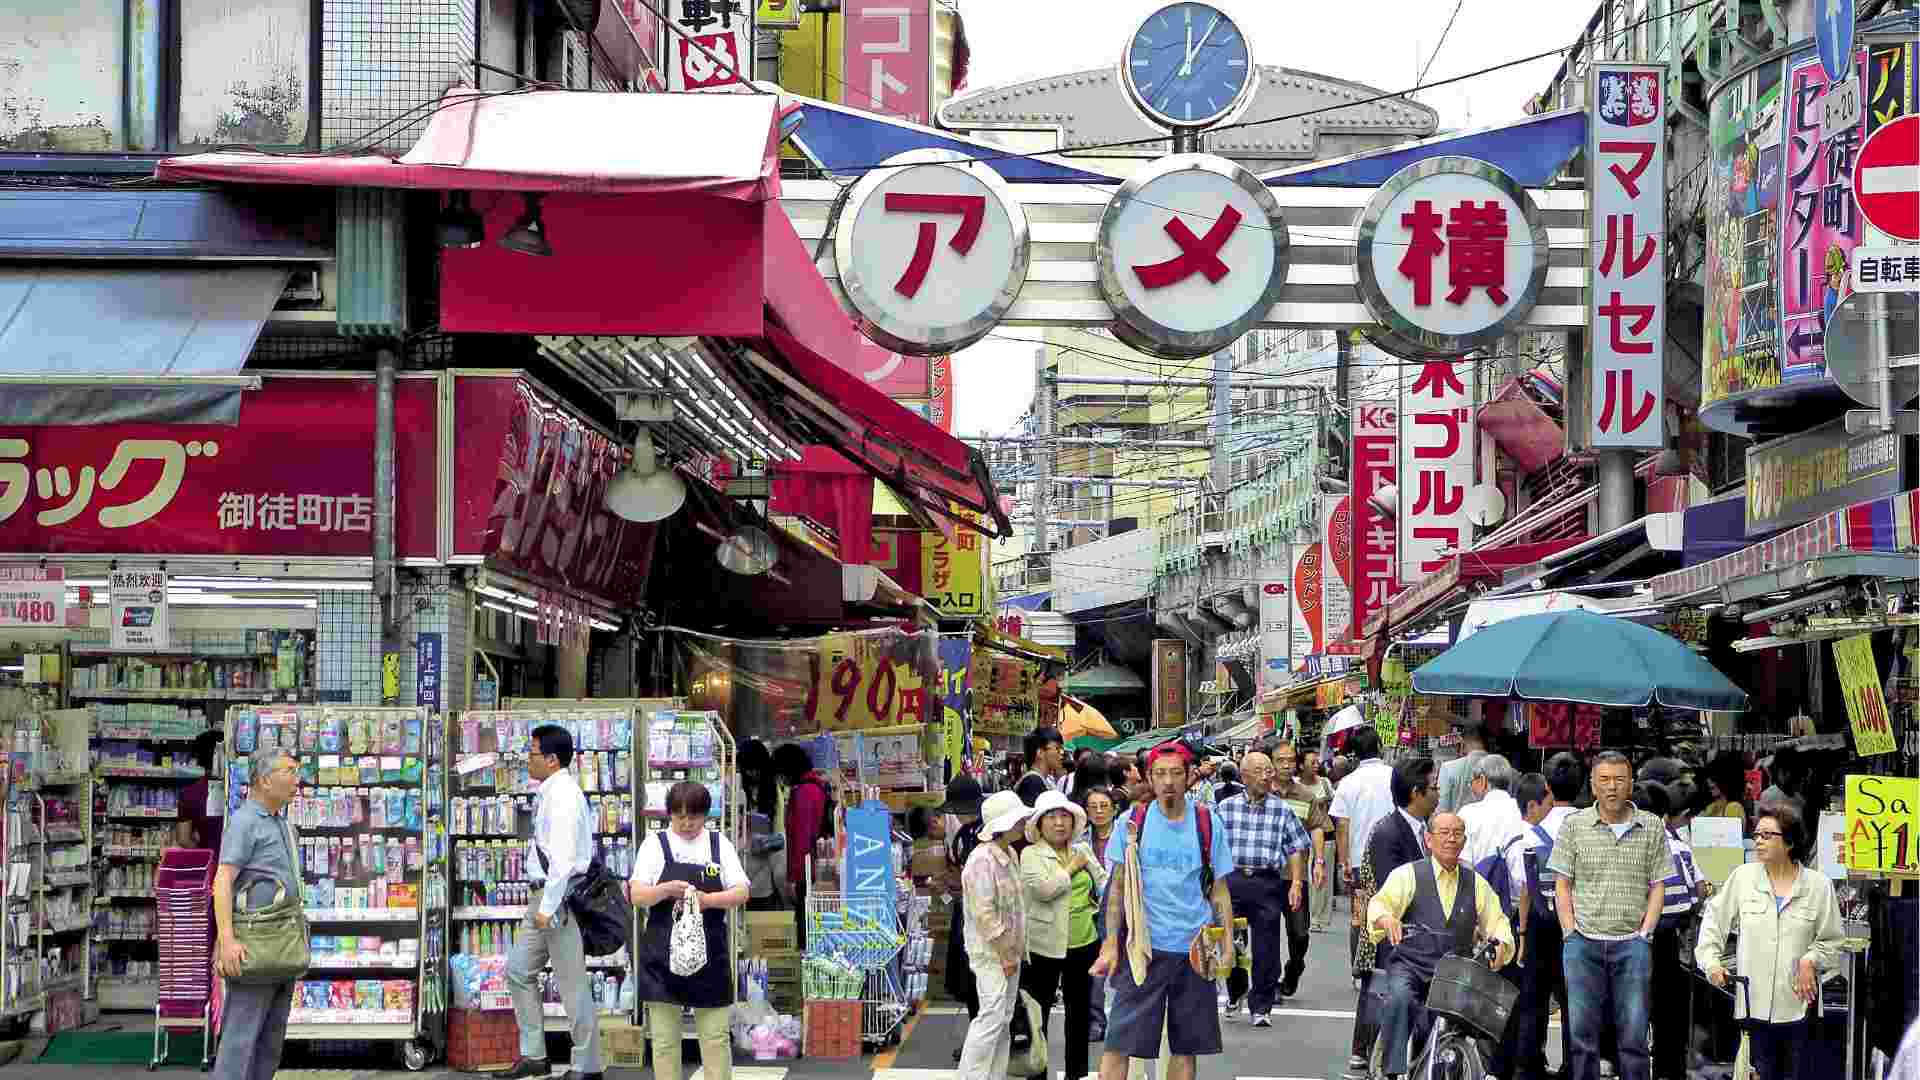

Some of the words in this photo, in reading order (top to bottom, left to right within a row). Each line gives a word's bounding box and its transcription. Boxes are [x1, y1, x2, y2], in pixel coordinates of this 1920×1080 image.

[1598, 142, 1658, 434] マルセル
[1860, 255, 1920, 283] 自転車
[217, 493, 371, 531] 御徒町店
[943, 592, 974, 607] 入口
[1303, 553, 1319, 611] ロンドン
[1856, 778, 1911, 816] Sa
